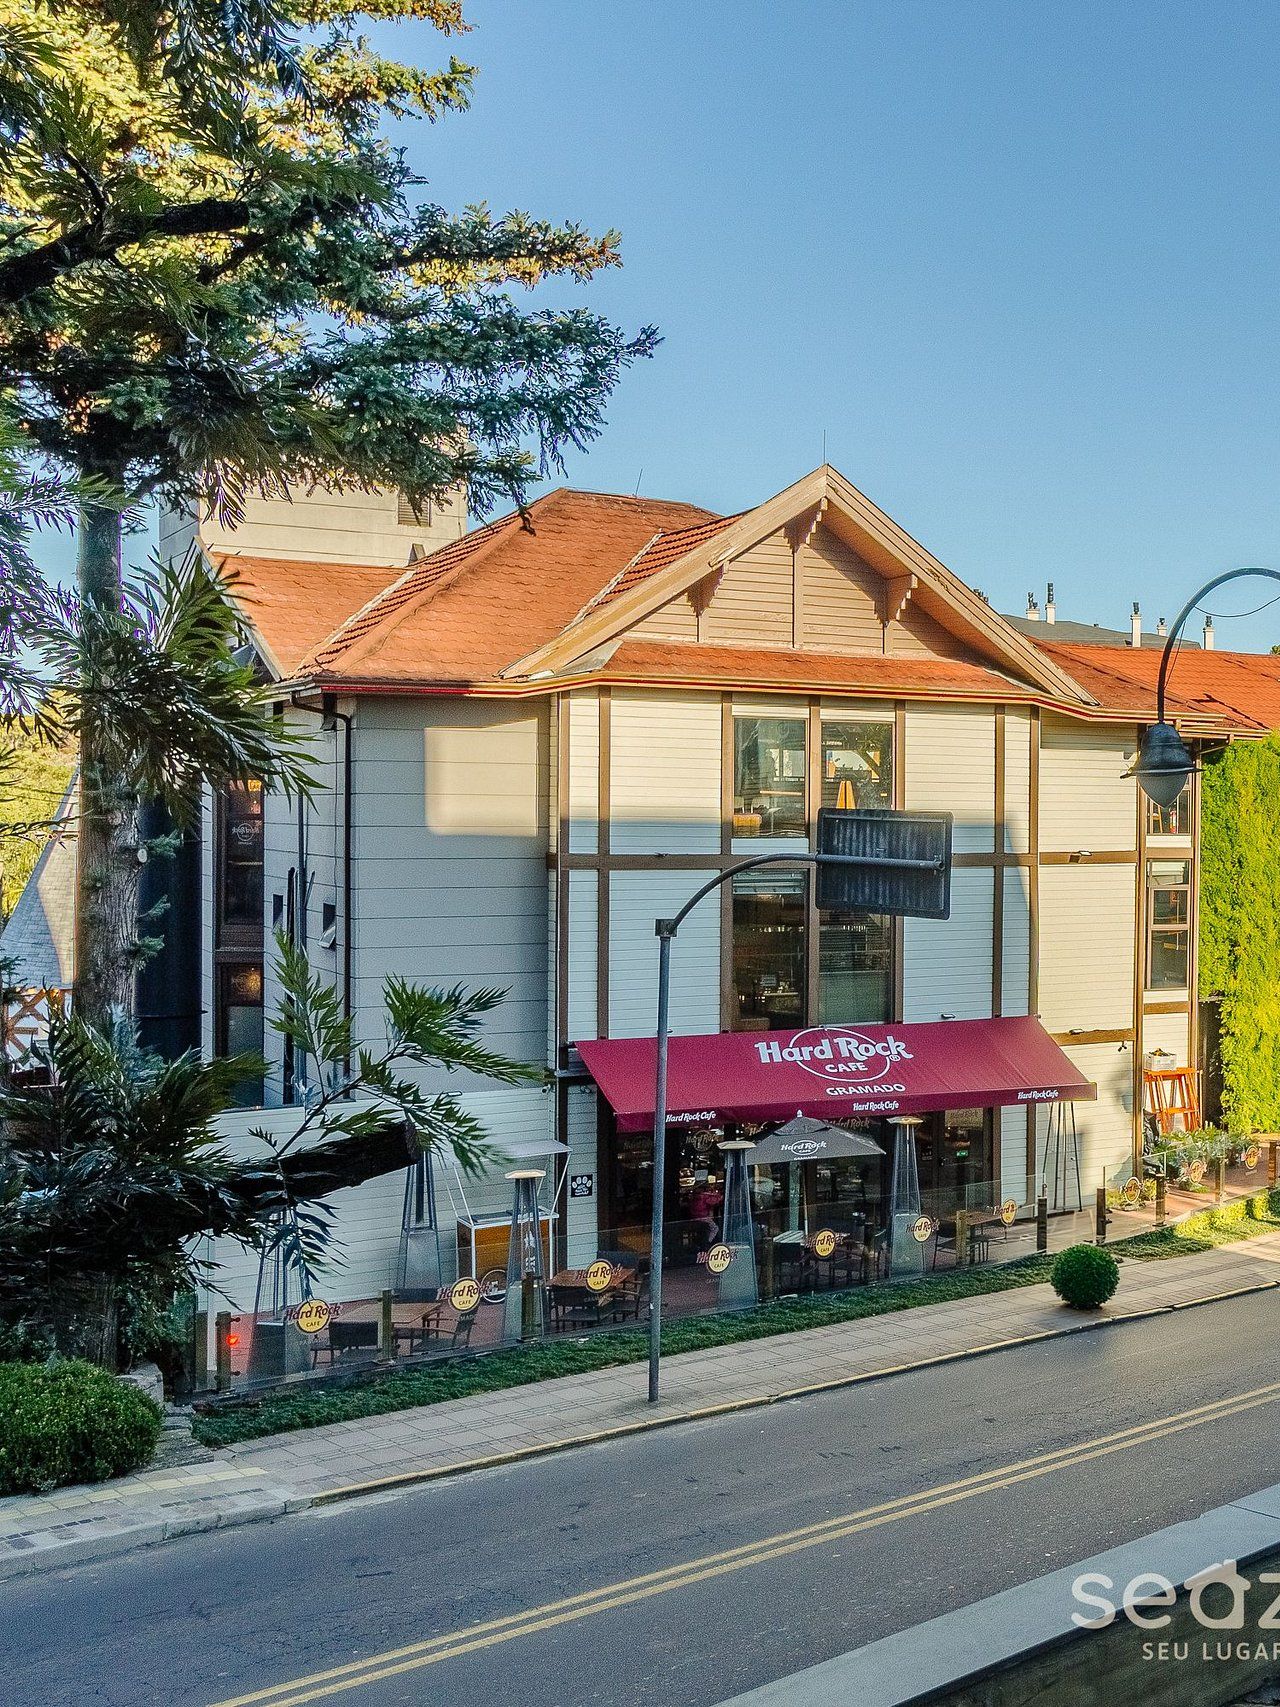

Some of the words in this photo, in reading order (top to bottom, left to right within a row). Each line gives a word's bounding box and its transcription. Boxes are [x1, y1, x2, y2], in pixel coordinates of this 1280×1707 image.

[754, 1039, 833, 1063] Hard
[834, 1036, 914, 1061] Rock
[825, 1062, 868, 1073] CAFE
[826, 1083, 906, 1096] GRAMADO
[1017, 1091, 1033, 1100] Hard
[1032, 1090, 1046, 1099] Rock
[853, 1102, 869, 1111] Hard
[869, 1101, 885, 1111] Rock
[884, 1100, 899, 1110] Cafe
[666, 1113, 684, 1123] Hard
[684, 1112, 700, 1123] Rock
[700, 1111, 717, 1120] Cafe
[804, 1141, 827, 1150] Rock
[576, 1267, 599, 1280] Hard
[438, 1285, 466, 1299] Hard
[466, 1284, 490, 1297] Rock
[286, 1306, 313, 1320] Hard
[314, 1304, 340, 1319] Rock
